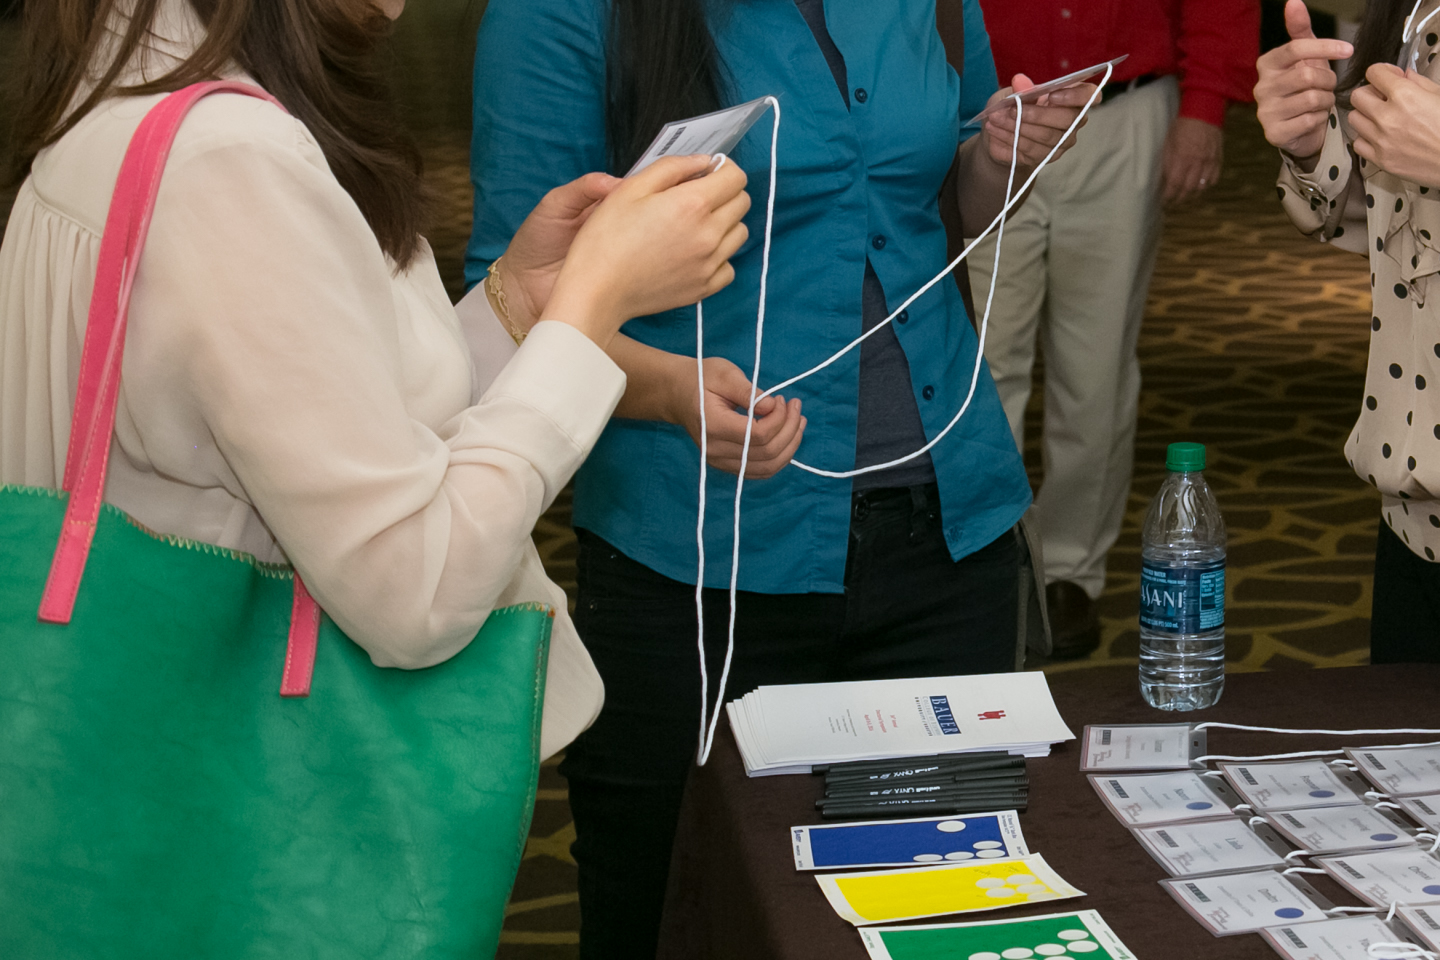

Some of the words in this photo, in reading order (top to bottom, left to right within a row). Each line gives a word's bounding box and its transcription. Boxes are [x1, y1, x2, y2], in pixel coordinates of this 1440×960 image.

[1141, 583, 1183, 608] ASANI
[931, 697, 958, 734] BAUER
[893, 769, 914, 778] ONYX
